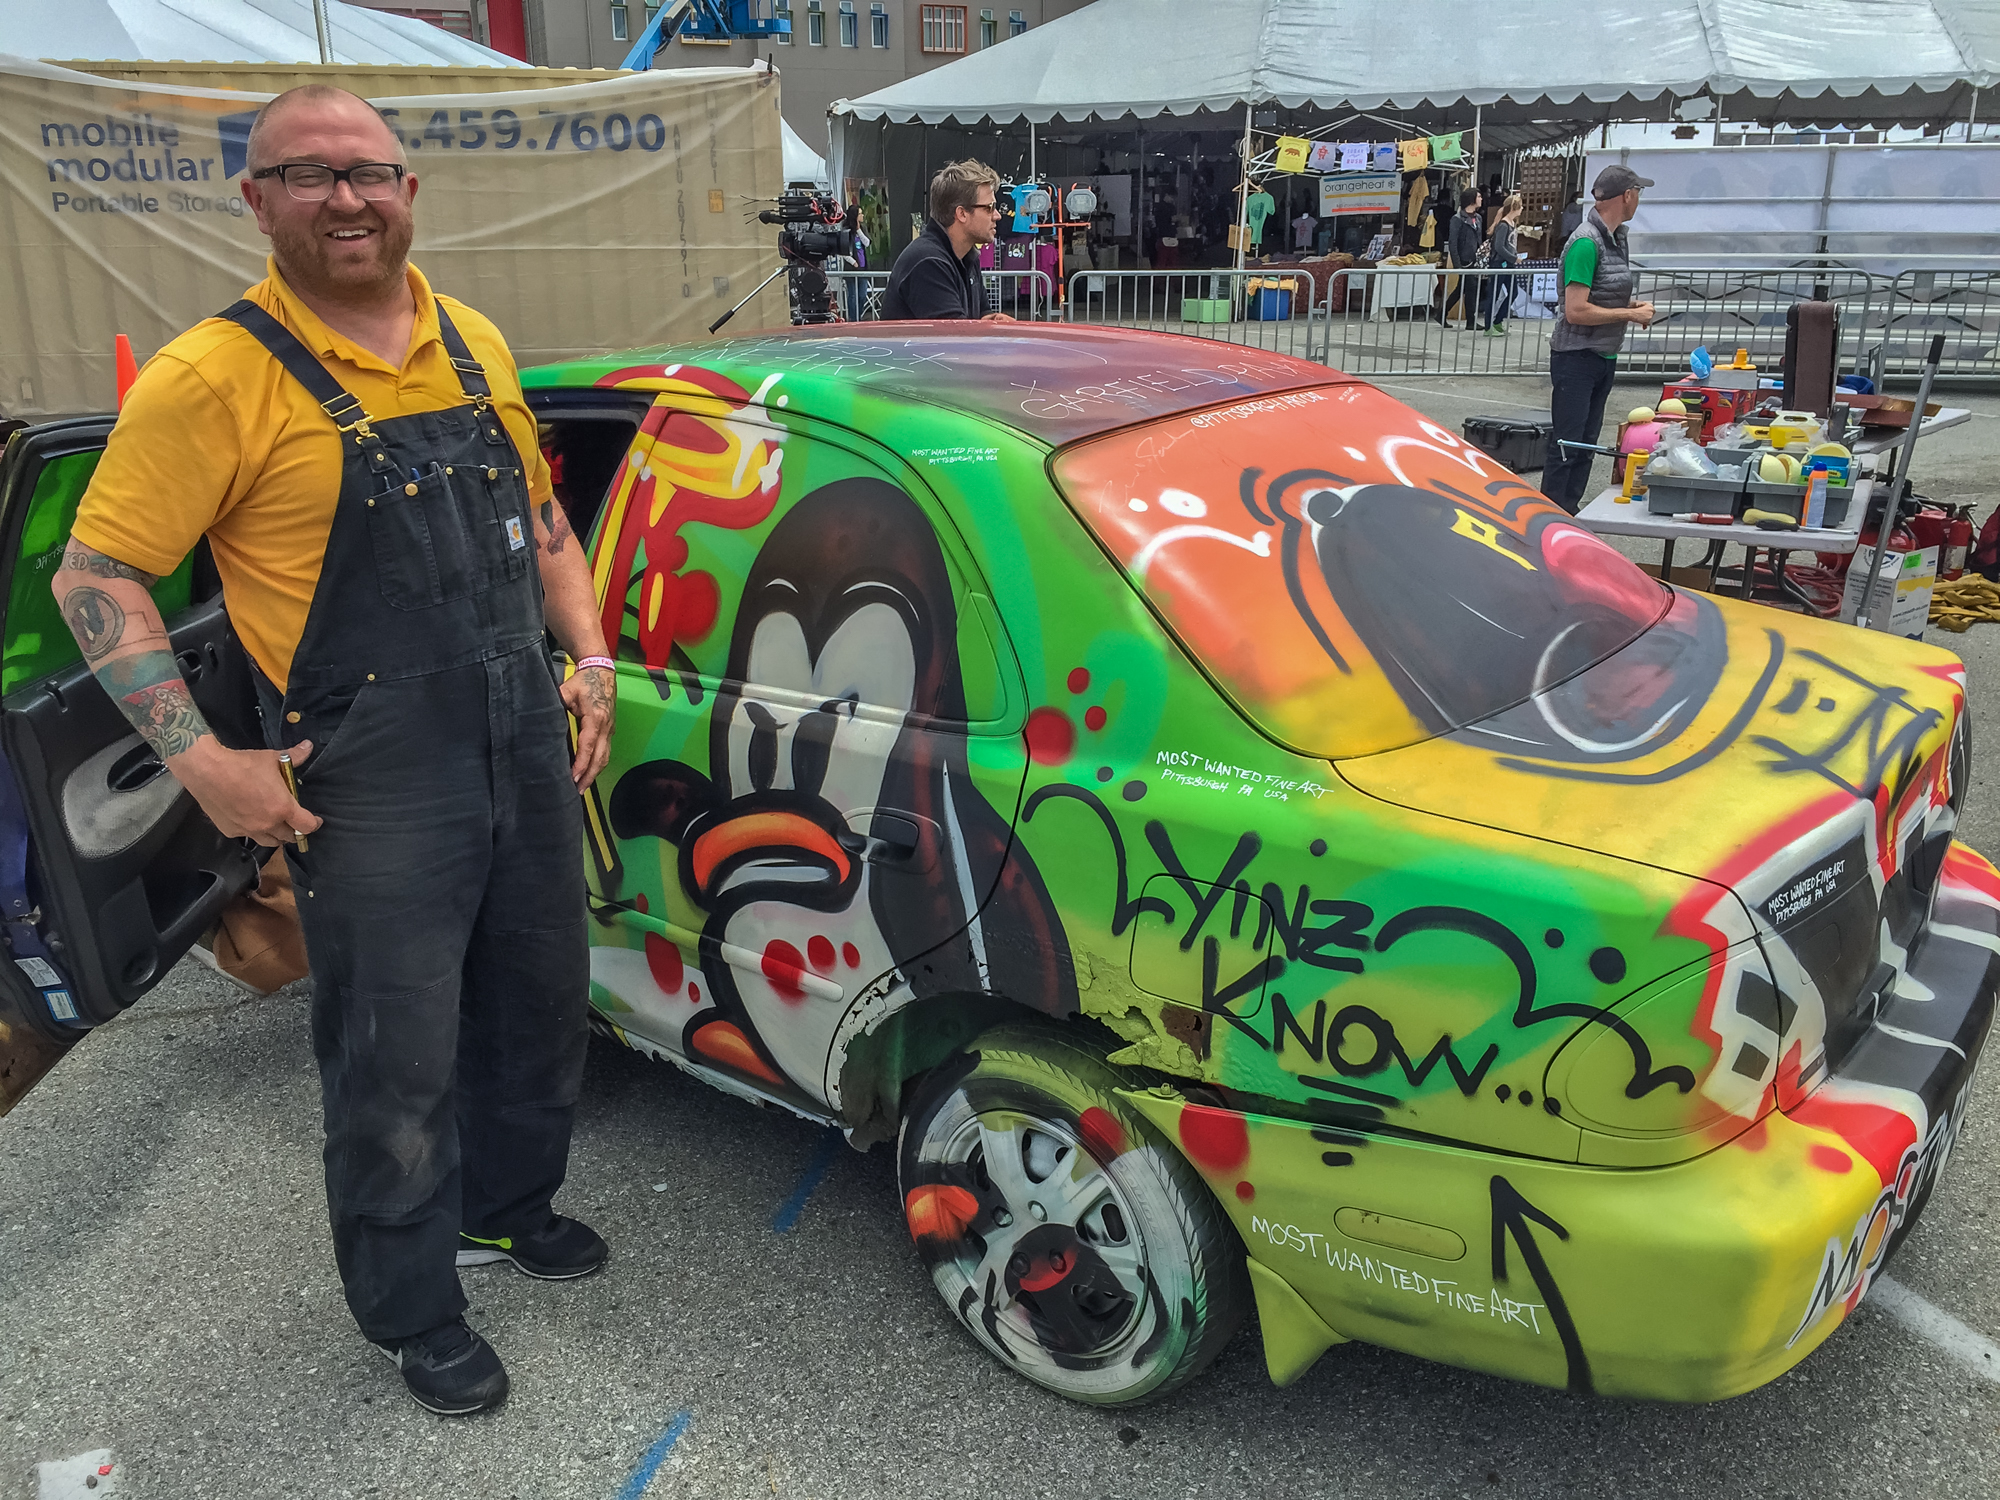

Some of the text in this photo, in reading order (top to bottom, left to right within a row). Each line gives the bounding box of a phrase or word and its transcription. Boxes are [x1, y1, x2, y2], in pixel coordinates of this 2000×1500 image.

[41, 114, 180, 147] mobile
[47, 149, 215, 182] modular
[1324, 181, 1385, 192] orangeheat
[52, 192, 249, 217] Portable Storag
[1020, 367, 1239, 420] GARFIELD
[931, 448, 966, 456] WANTED
[966, 447, 985, 455] FINE
[1156, 750, 1334, 799] MOST WANTED FINE ART
[1160, 768, 1289, 802] PITTSBURGH PA USA
[1768, 859, 1846, 916] MOST WANTED FINE ART
[1814, 889, 1824, 904] PA
[1825, 880, 1837, 895] USA
[1252, 1215, 1544, 1335] MOST WANTED FINE ART
